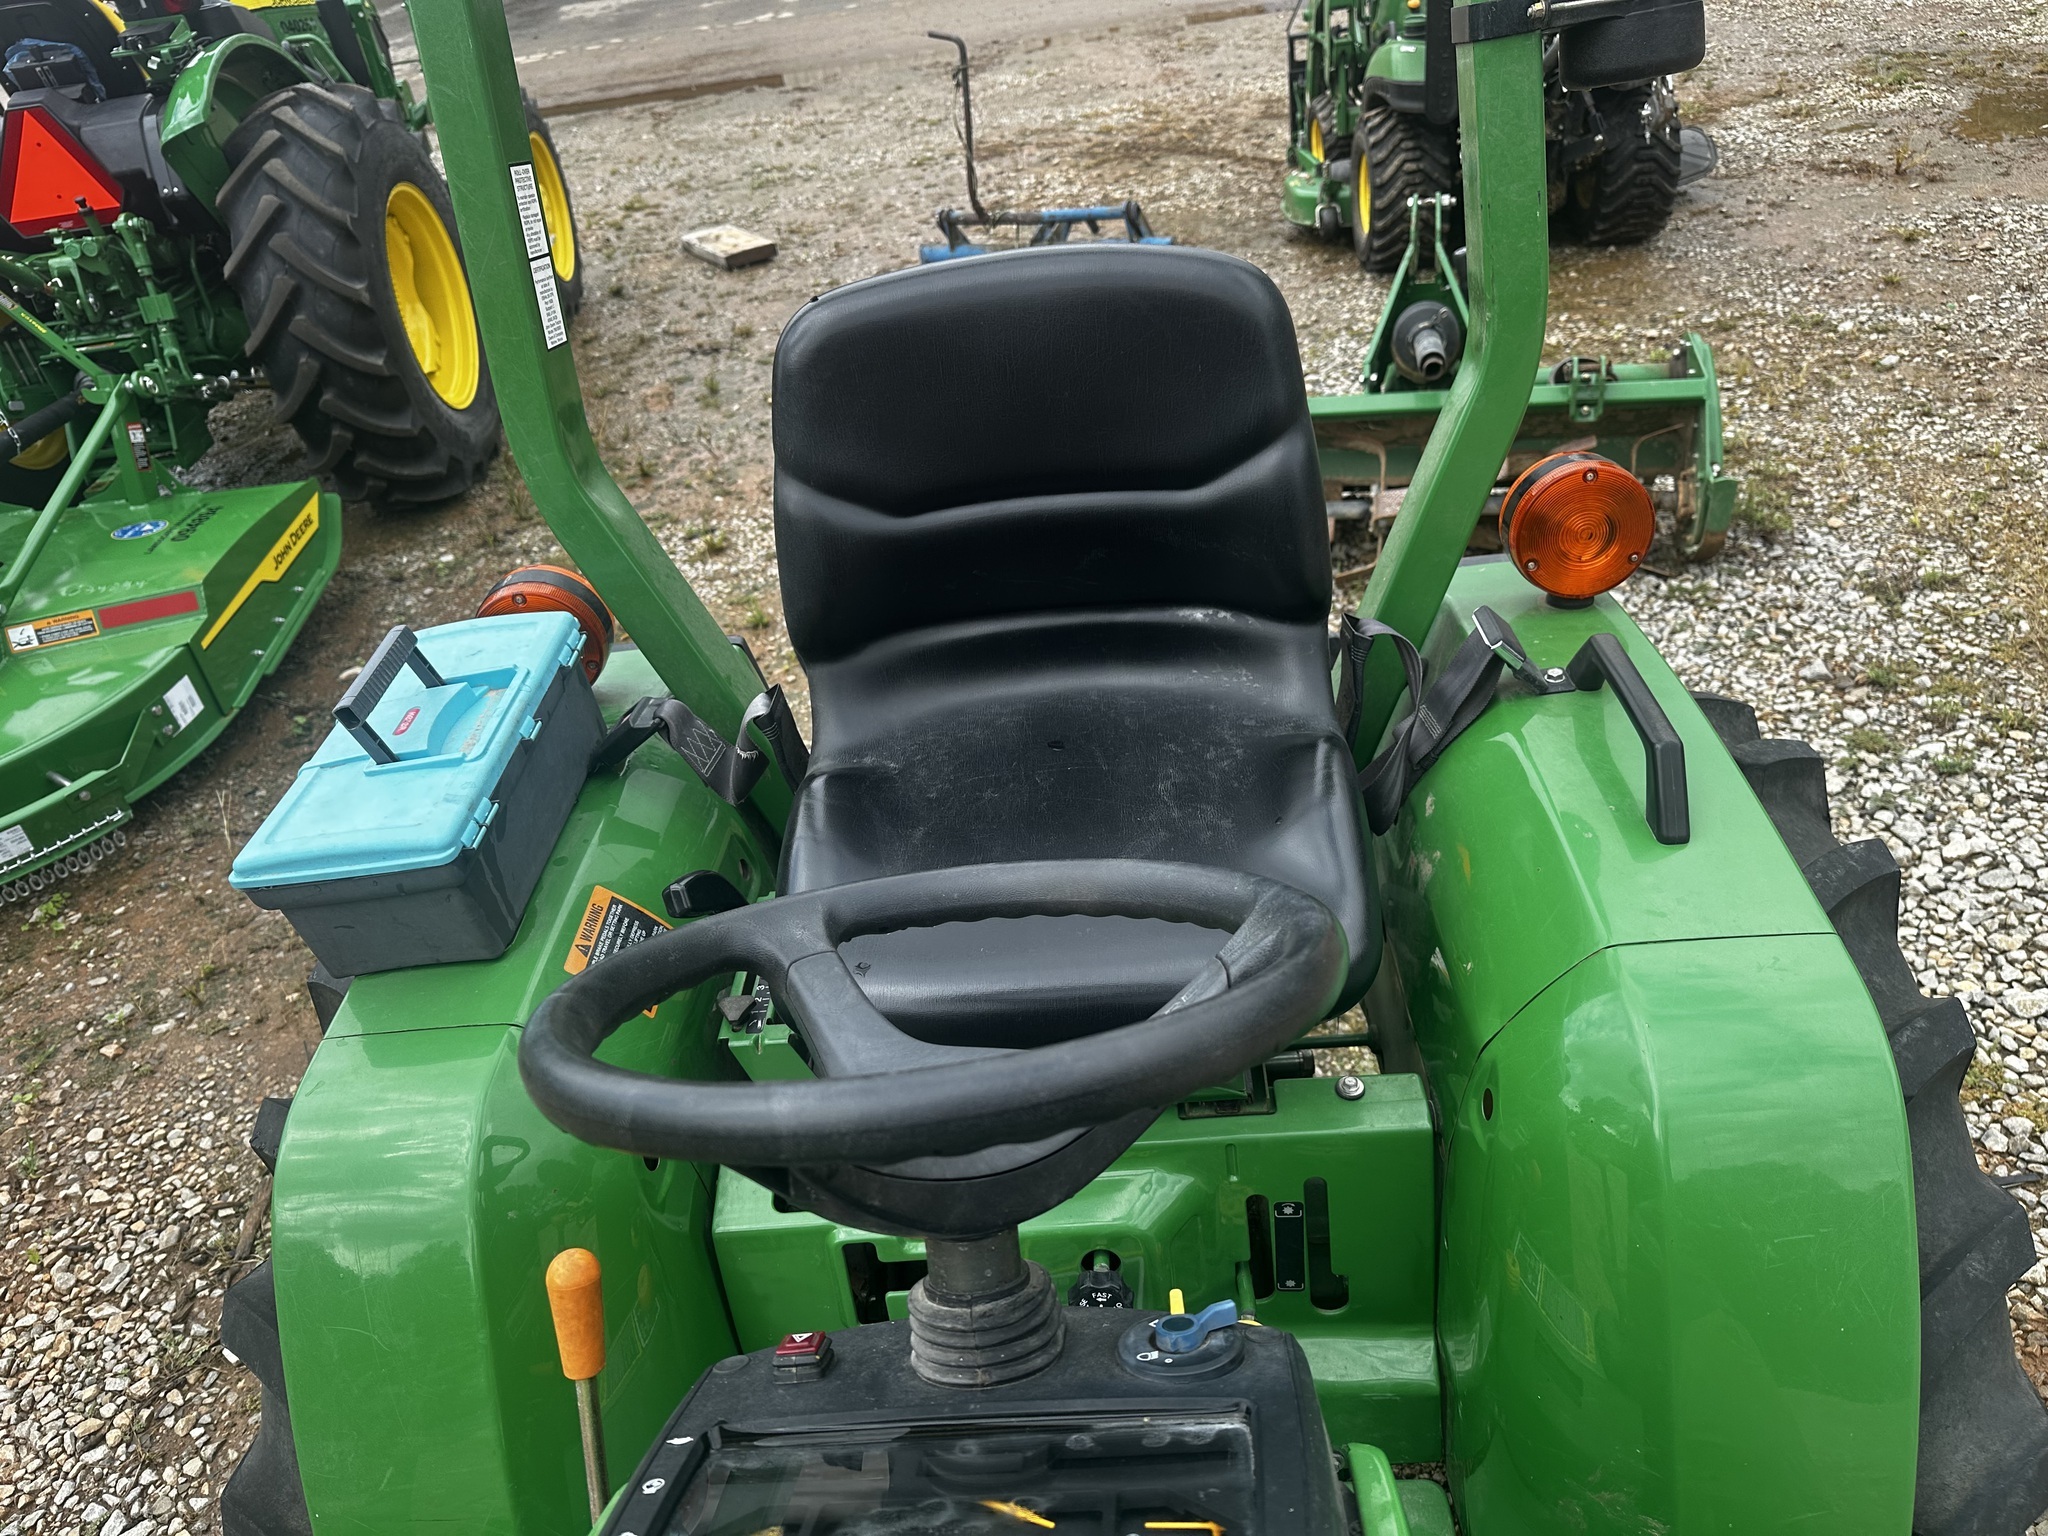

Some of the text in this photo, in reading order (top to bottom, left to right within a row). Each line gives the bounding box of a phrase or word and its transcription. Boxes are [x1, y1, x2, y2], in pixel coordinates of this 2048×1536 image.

[273, 512, 315, 571] JOHN DEERE
[580, 903, 604, 942] WARNING
[595, 941, 605, 957] BRAKE
[600, 925, 610, 942] PEDALS
[605, 904, 617, 925] TOGETHER
[601, 938, 611, 954] TRAVEL
[610, 914, 620, 931] SETTING
[620, 917, 630, 934] BEFORE
[630, 920, 640, 940] DEPRESS
